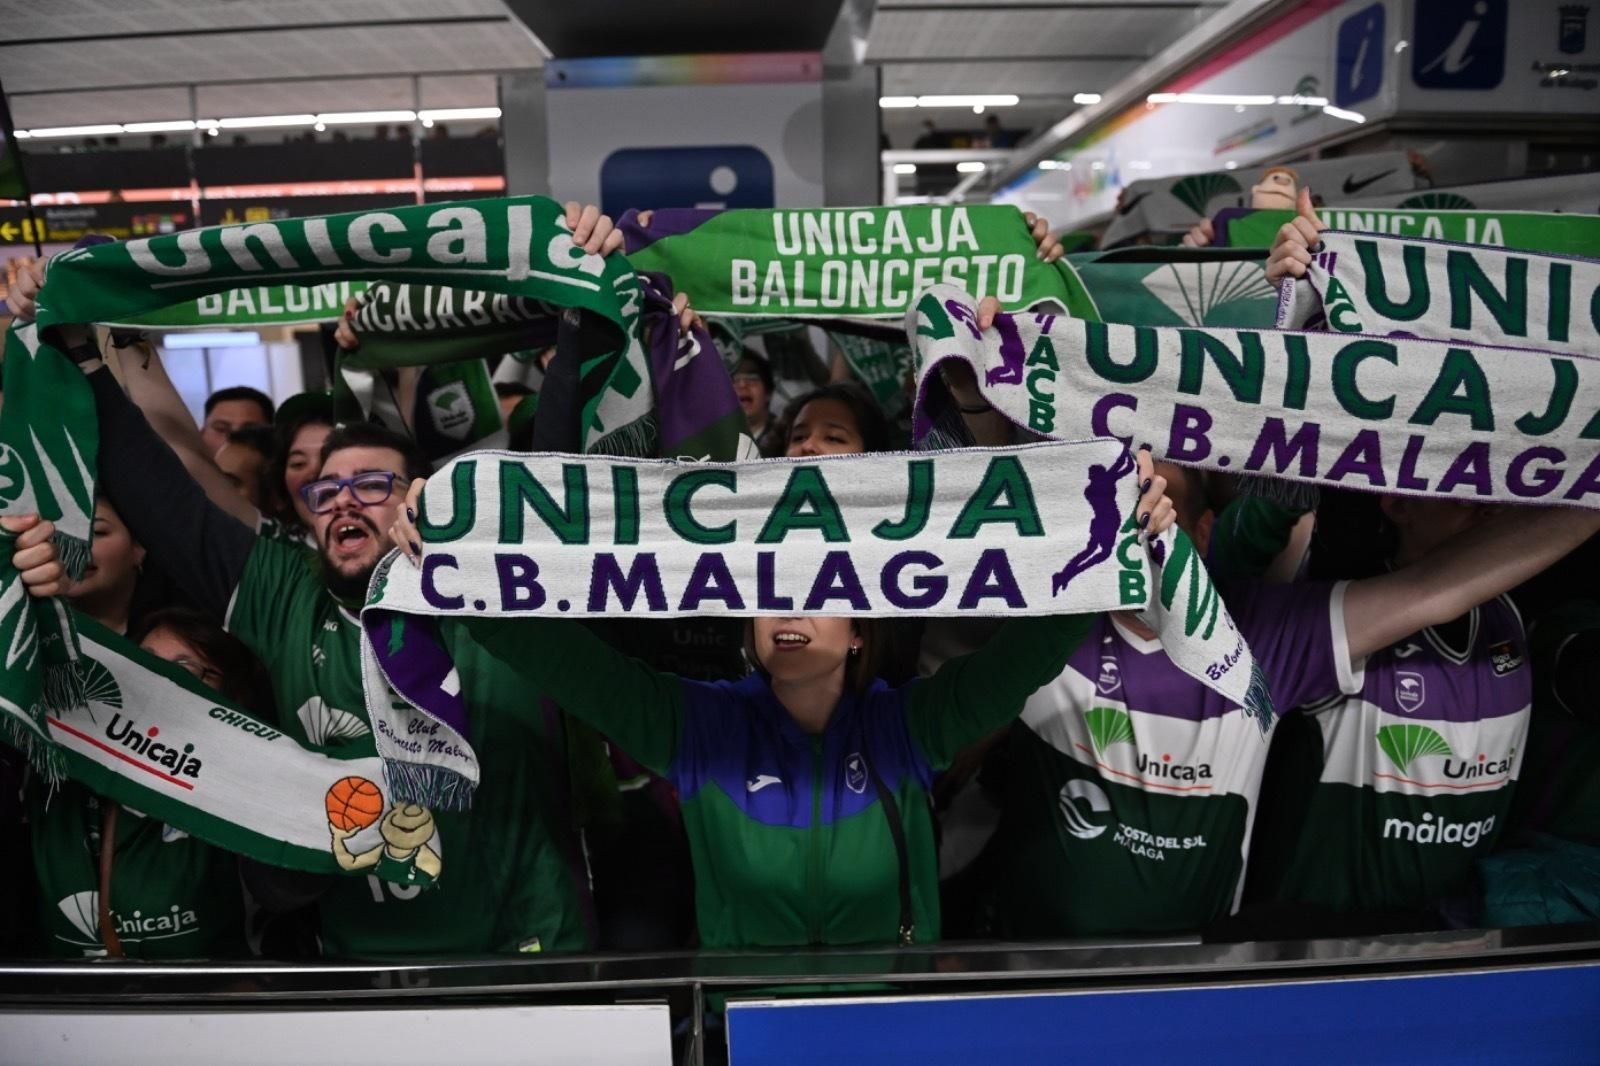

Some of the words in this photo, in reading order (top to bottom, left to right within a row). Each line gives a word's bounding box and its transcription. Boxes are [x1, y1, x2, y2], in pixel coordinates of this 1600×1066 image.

[774, 209, 978, 255] UNICAJA
[732, 255, 1024, 306] BALONCESTO
[1355, 240, 1600, 343] UNI
[1086, 323, 1600, 440] UNICAJ
[419, 456, 1046, 545] UNICAJA
[105, 713, 202, 778] Unicaja
[409, 718, 441, 735] Club
[1136, 753, 1213, 784] Unicaja
[1155, 835, 1181, 850] DEL
